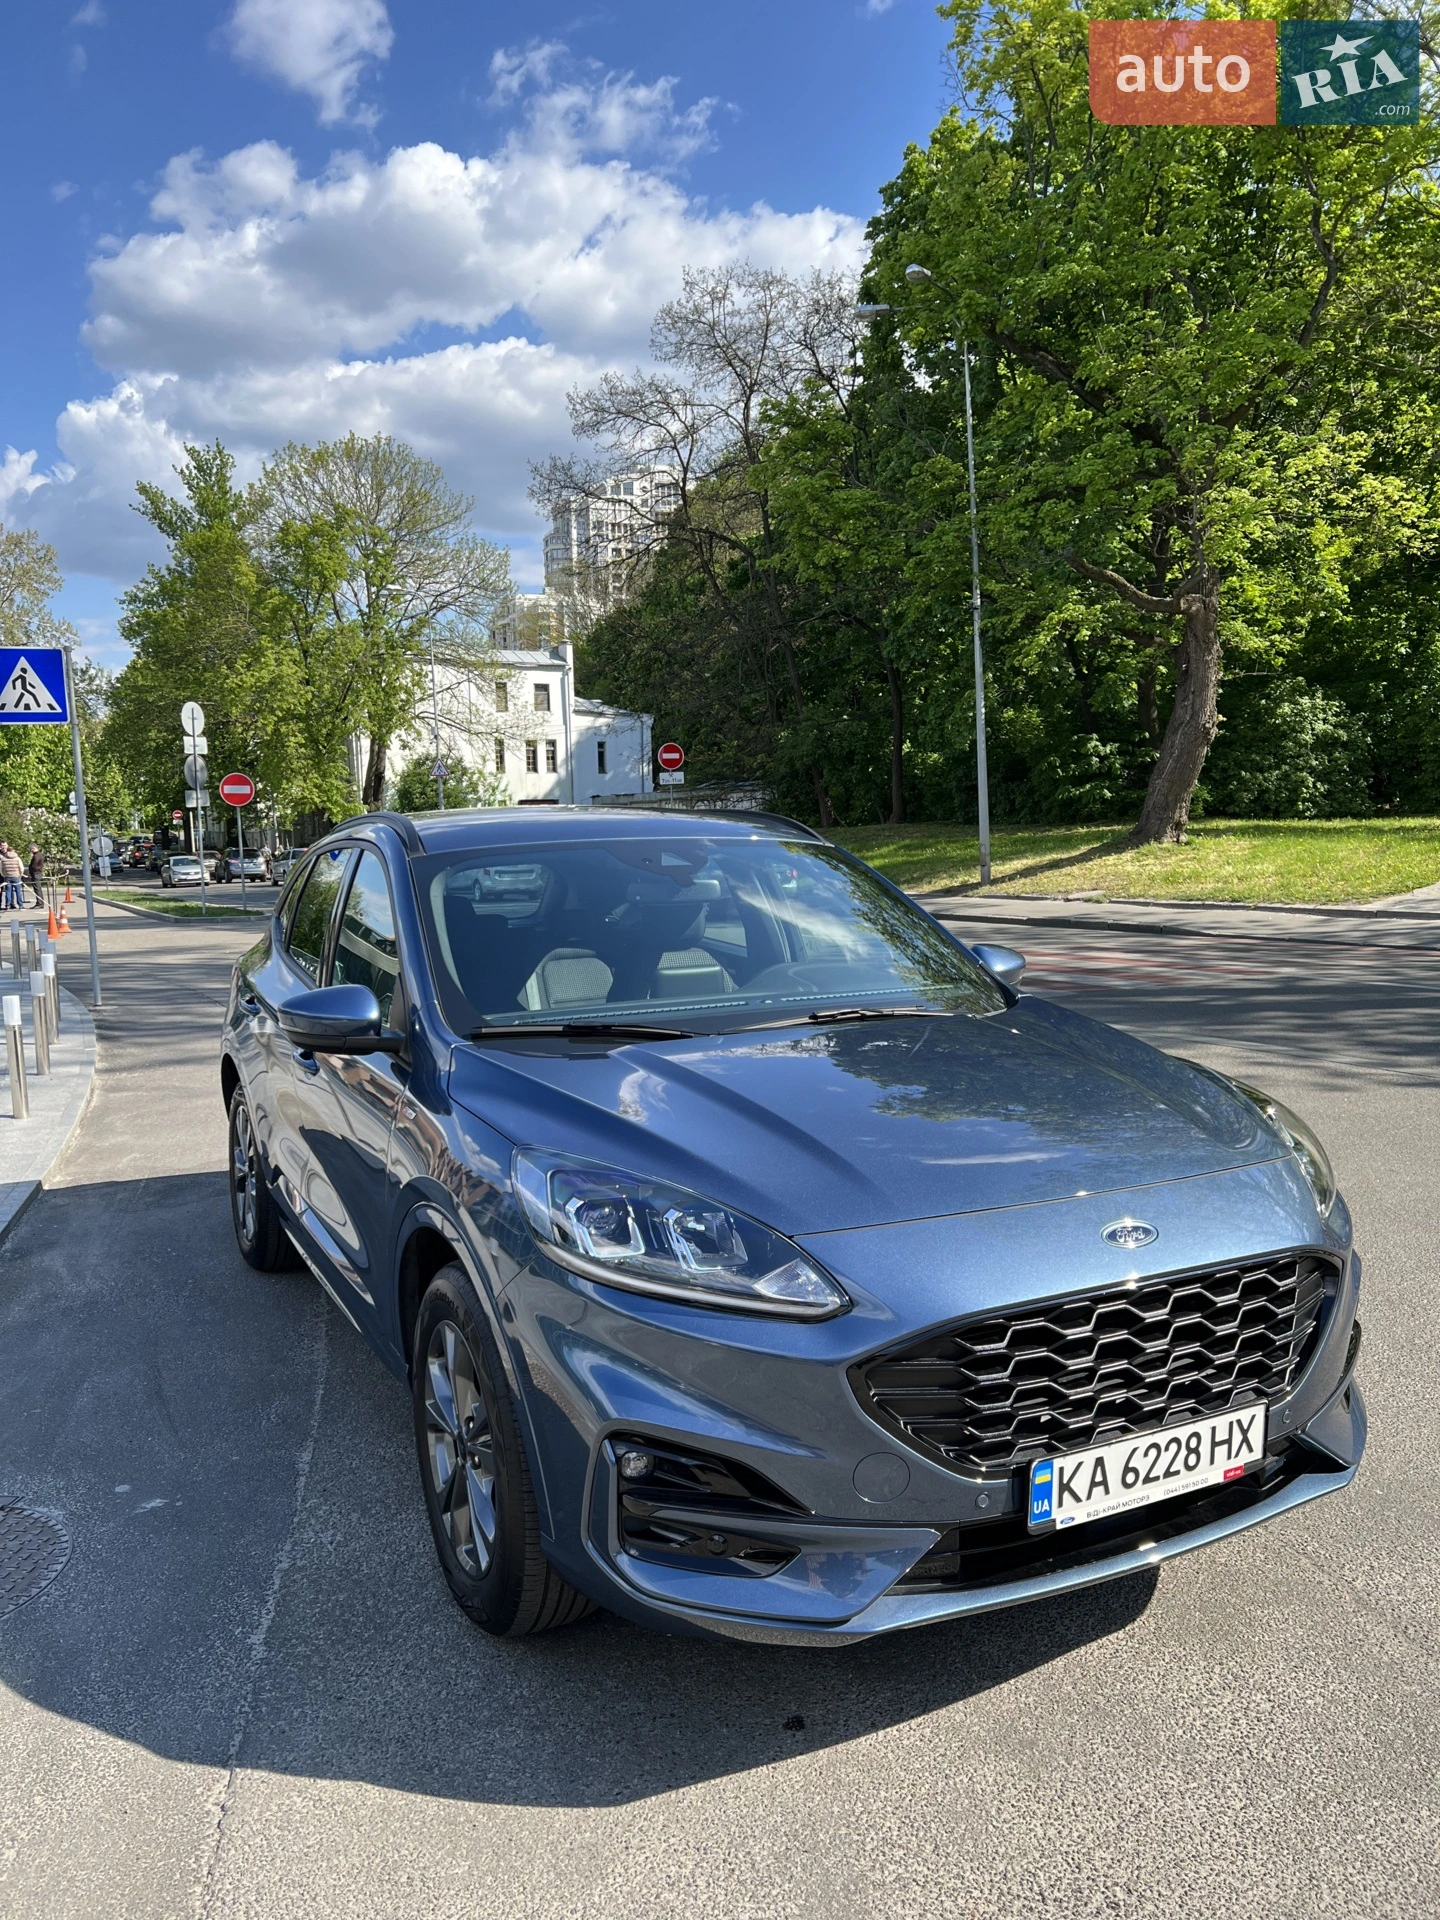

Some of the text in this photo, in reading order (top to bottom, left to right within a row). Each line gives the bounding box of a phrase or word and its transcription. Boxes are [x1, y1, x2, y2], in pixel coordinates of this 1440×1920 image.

[1058, 1414, 1257, 1508] KA 6228 HX
[1163, 1485, 1181, 1496] (044)
[1181, 1482, 1191, 1491] 591
[1200, 1477, 1209, 1485] 00
[1033, 1498, 1050, 1514] UA
